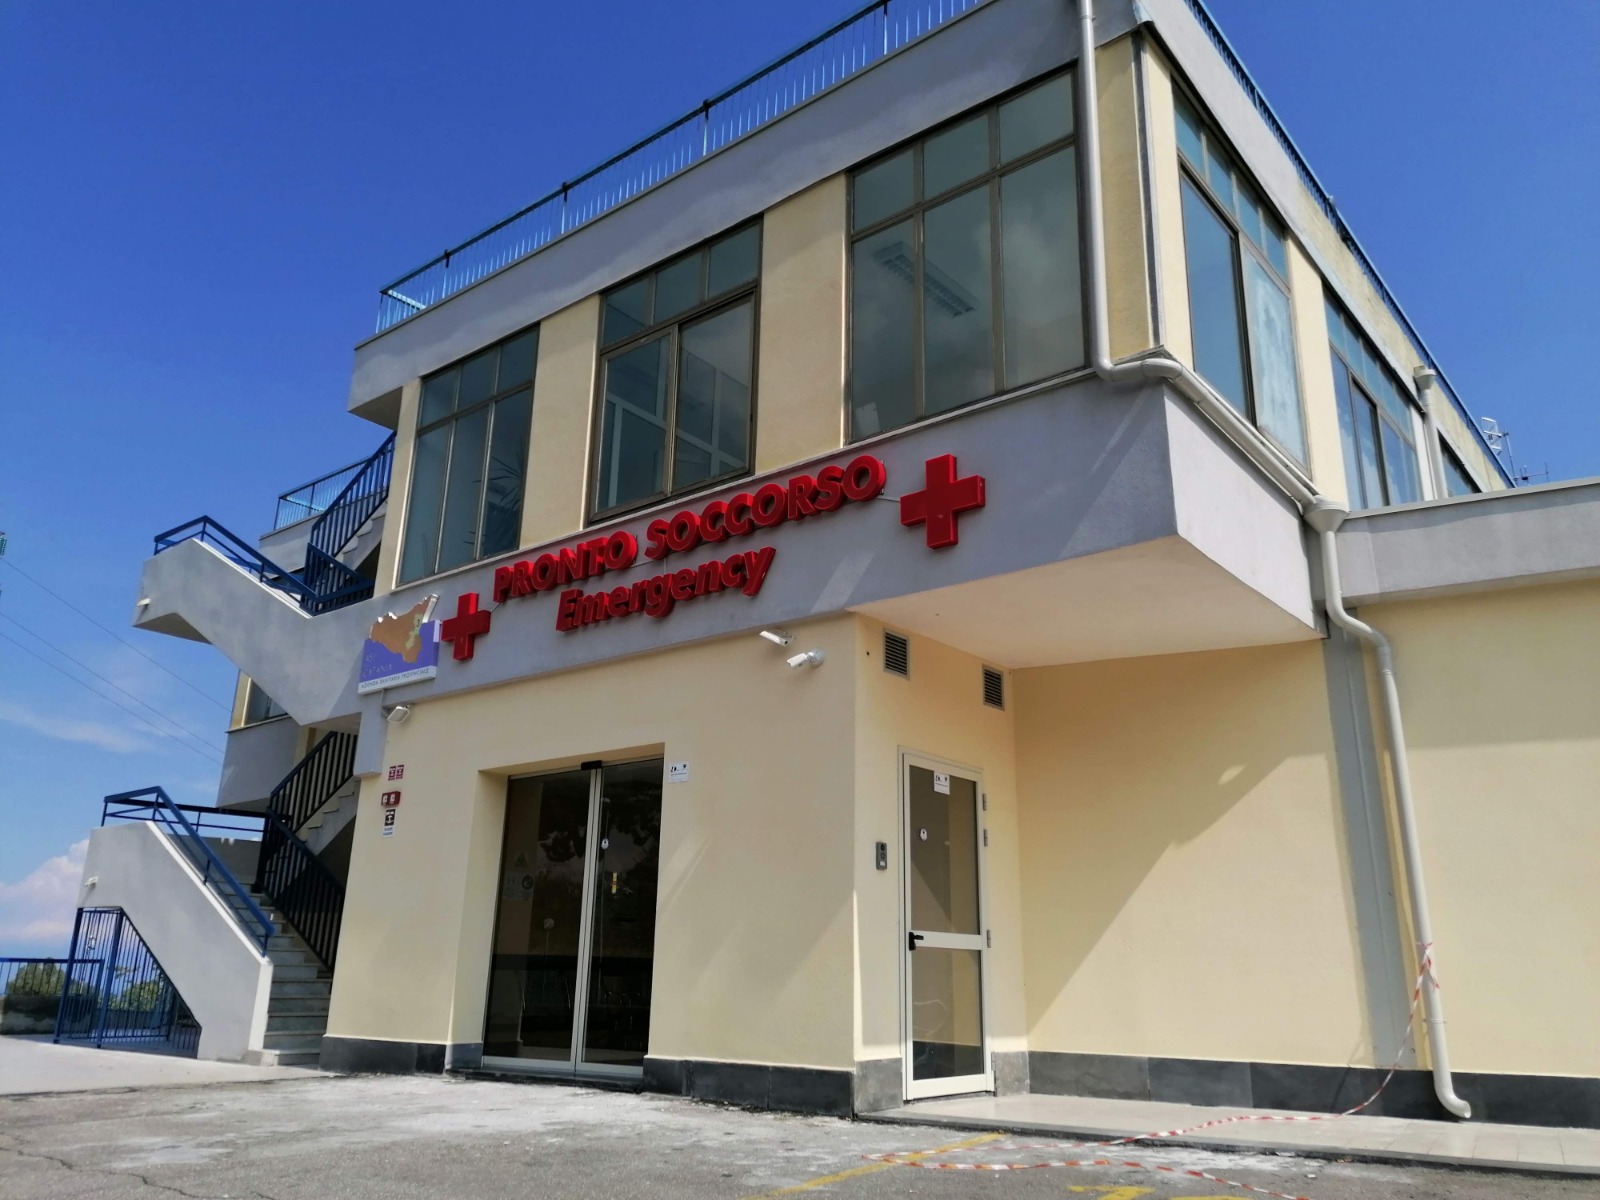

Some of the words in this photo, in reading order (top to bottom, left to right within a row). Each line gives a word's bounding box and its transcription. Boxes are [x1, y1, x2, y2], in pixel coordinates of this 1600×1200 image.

[493, 530, 637, 602] PRONTO
[644, 454, 886, 559] SOCCORSO
[555, 547, 776, 631] Emergency
